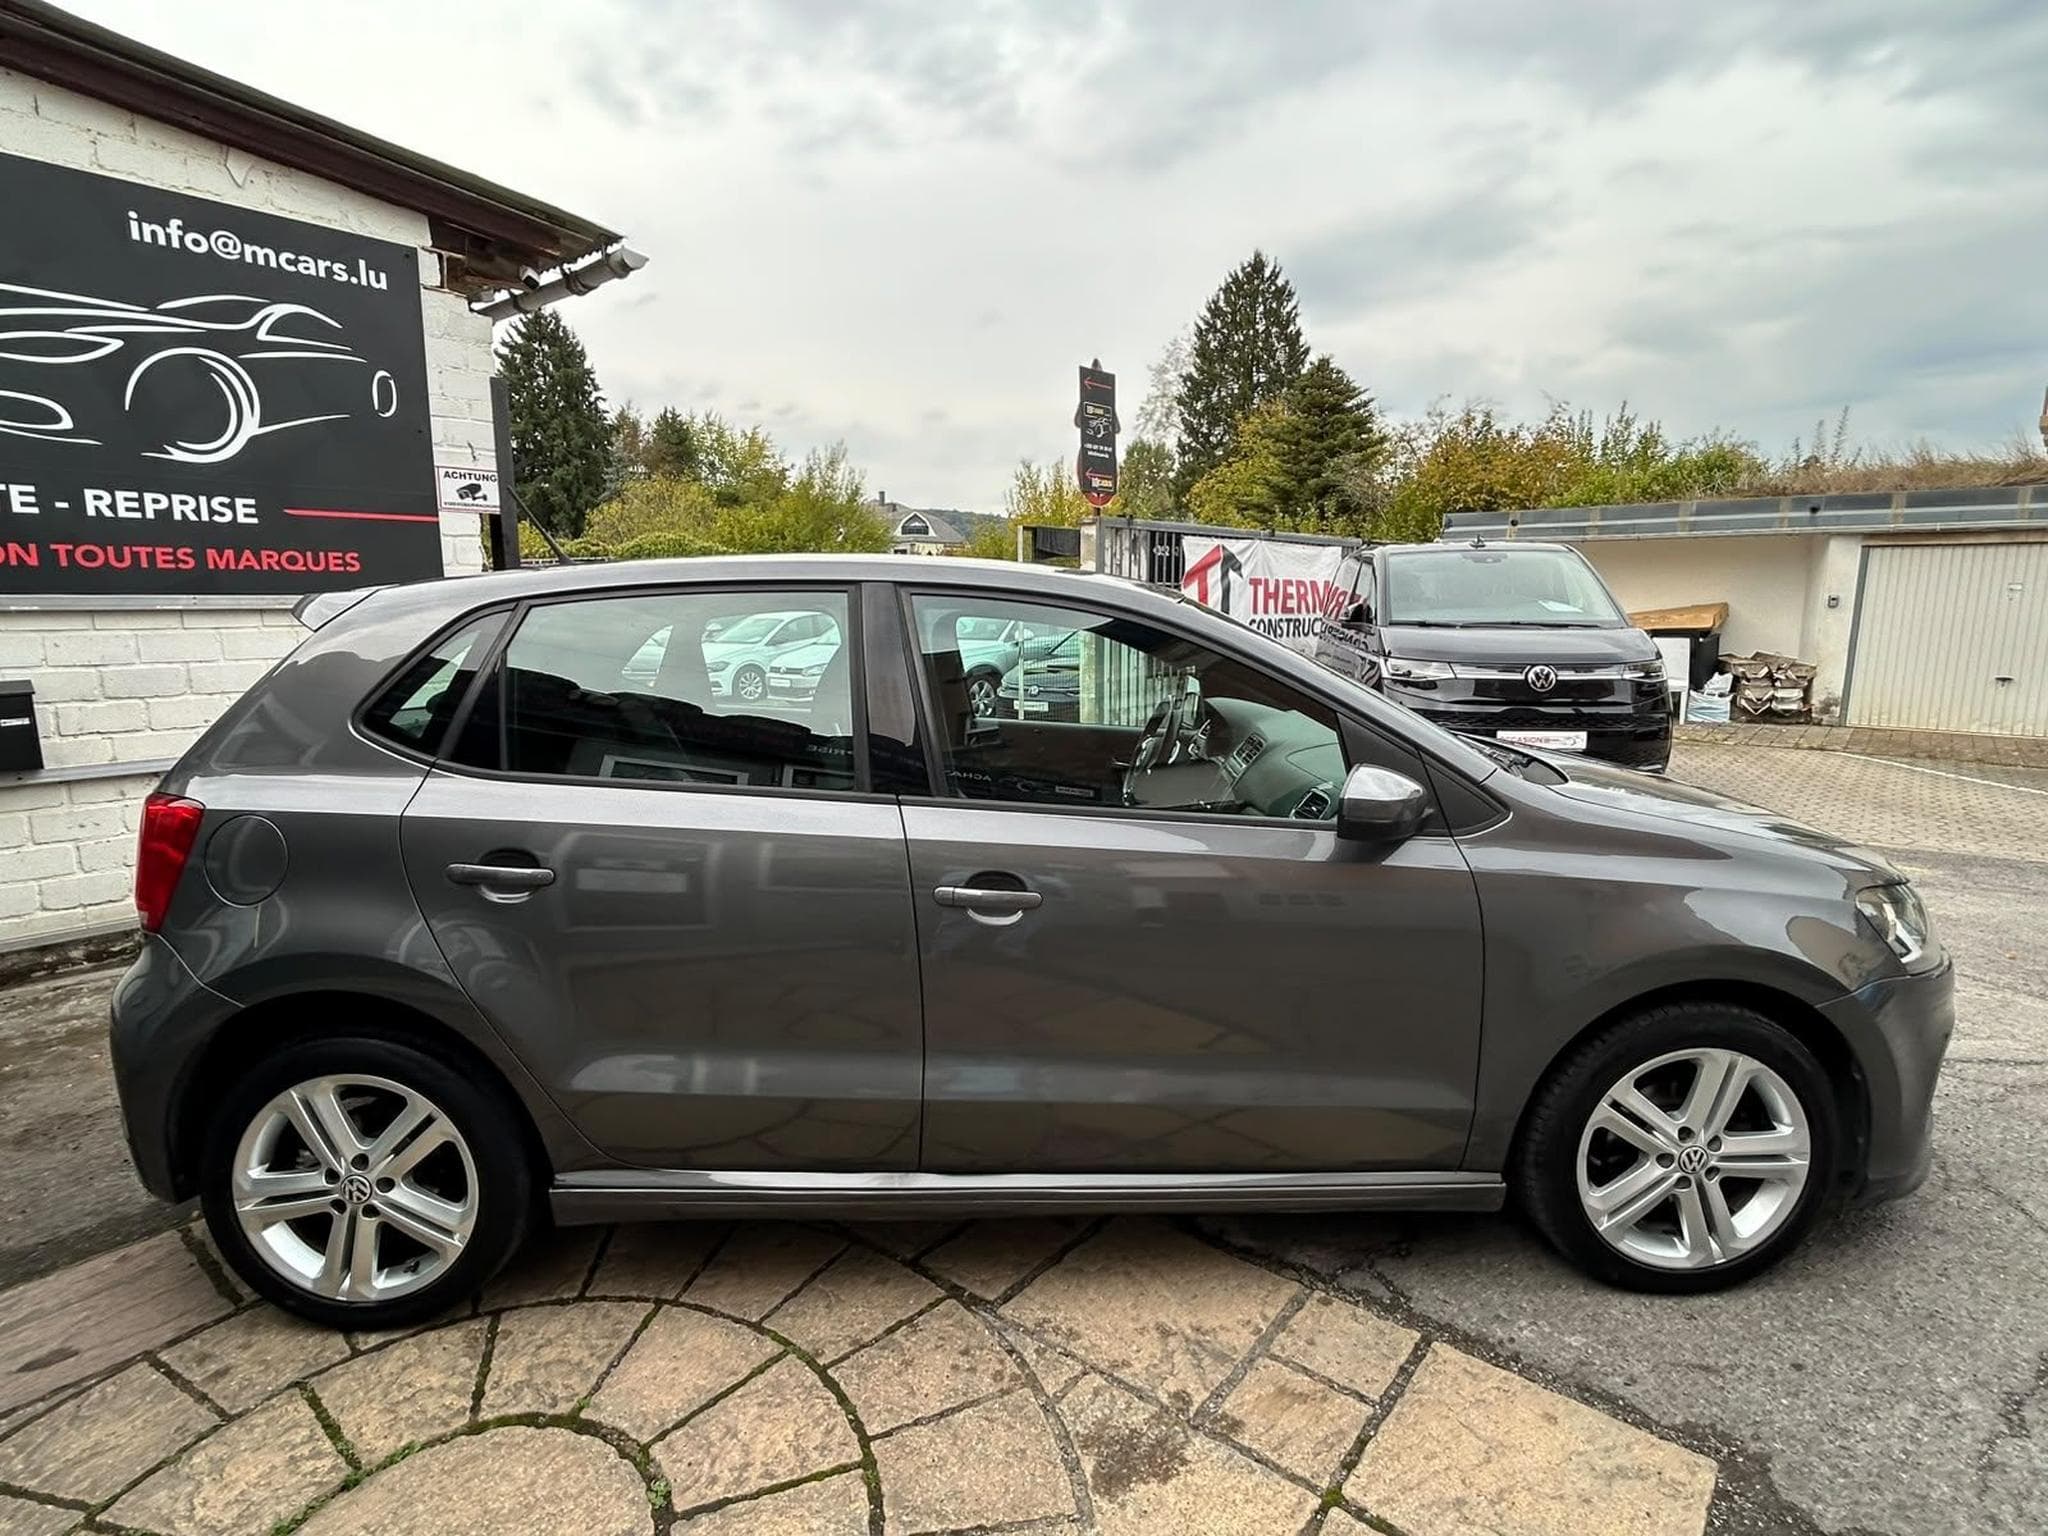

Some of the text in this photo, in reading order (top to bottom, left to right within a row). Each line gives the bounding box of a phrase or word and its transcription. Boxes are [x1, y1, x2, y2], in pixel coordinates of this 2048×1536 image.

[127, 210, 389, 290] info@mcars.lu
[443, 470, 498, 482] ACHTUNG
[0, 483, 40, 514] E
[83, 487, 260, 525] REPRISE
[0, 543, 362, 573] N TOUTES MARQUES
